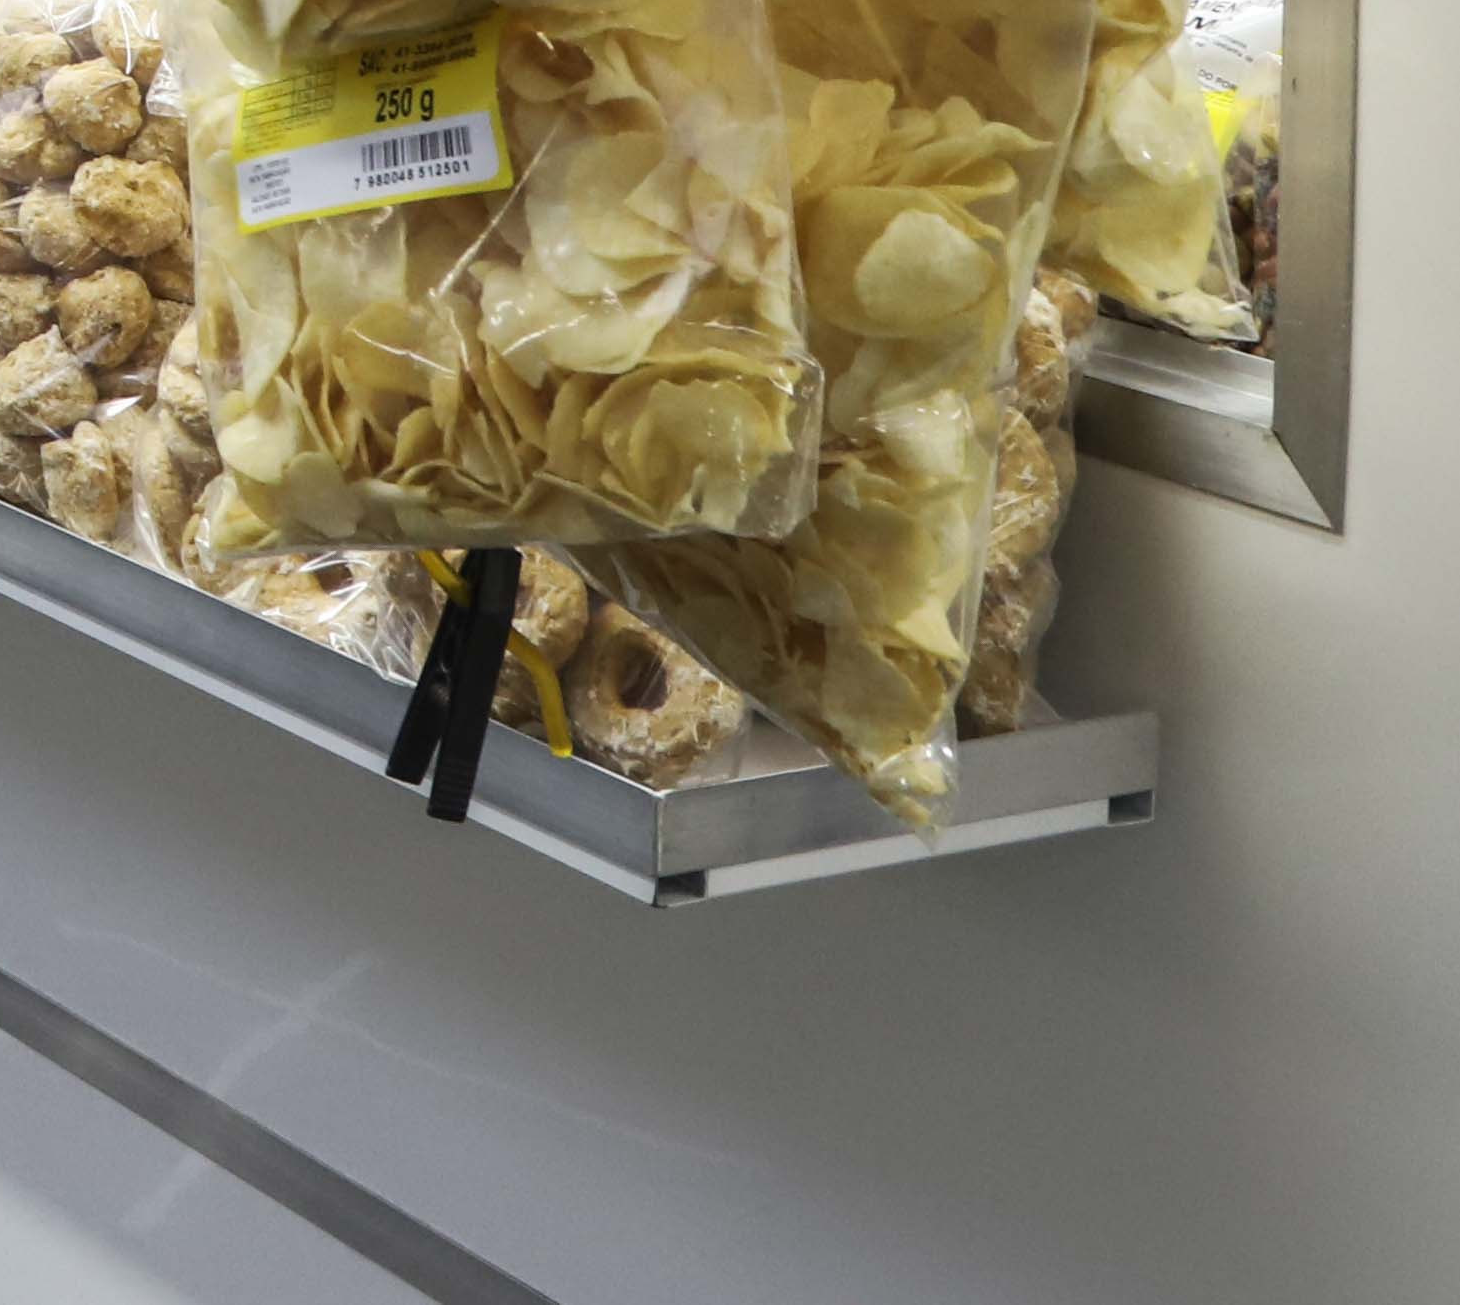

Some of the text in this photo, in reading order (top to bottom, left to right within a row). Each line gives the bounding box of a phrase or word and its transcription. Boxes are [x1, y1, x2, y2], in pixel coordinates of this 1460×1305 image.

[375, 86, 435, 123] 250 g
[354, 177, 361, 191] 7
[418, 160, 471, 179] 512501
